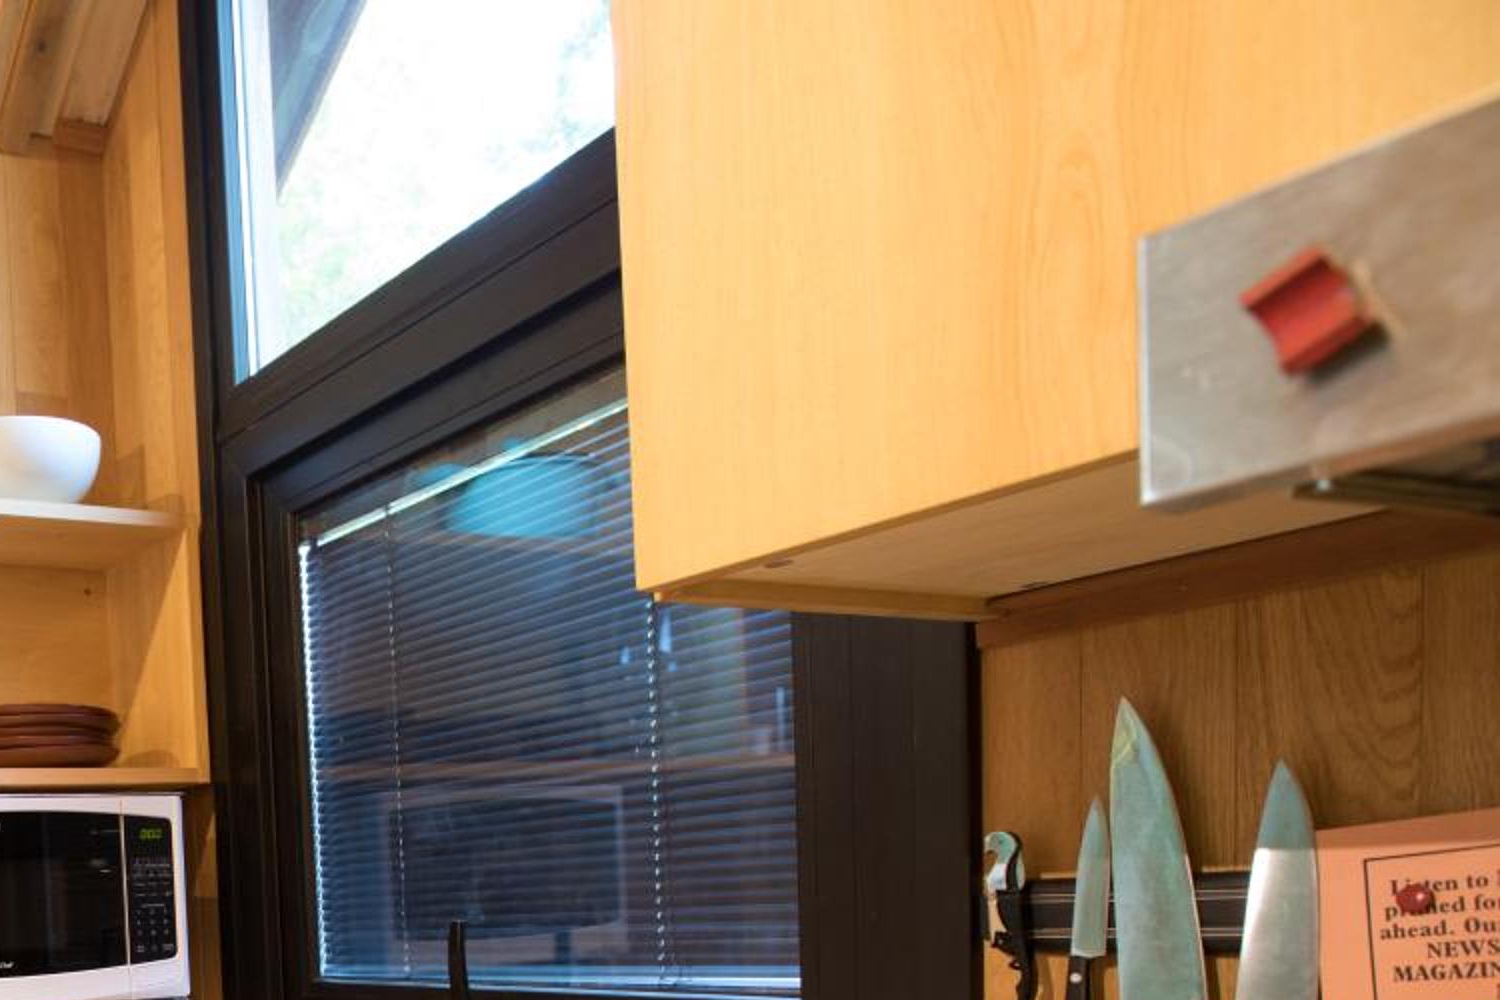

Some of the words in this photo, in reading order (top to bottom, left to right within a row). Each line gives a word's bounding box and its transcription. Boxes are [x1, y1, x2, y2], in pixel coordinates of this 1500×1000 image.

[1465, 874, 1490, 889] to
[1474, 893, 1500, 911] fo
[1380, 919, 1456, 940] ahead.
